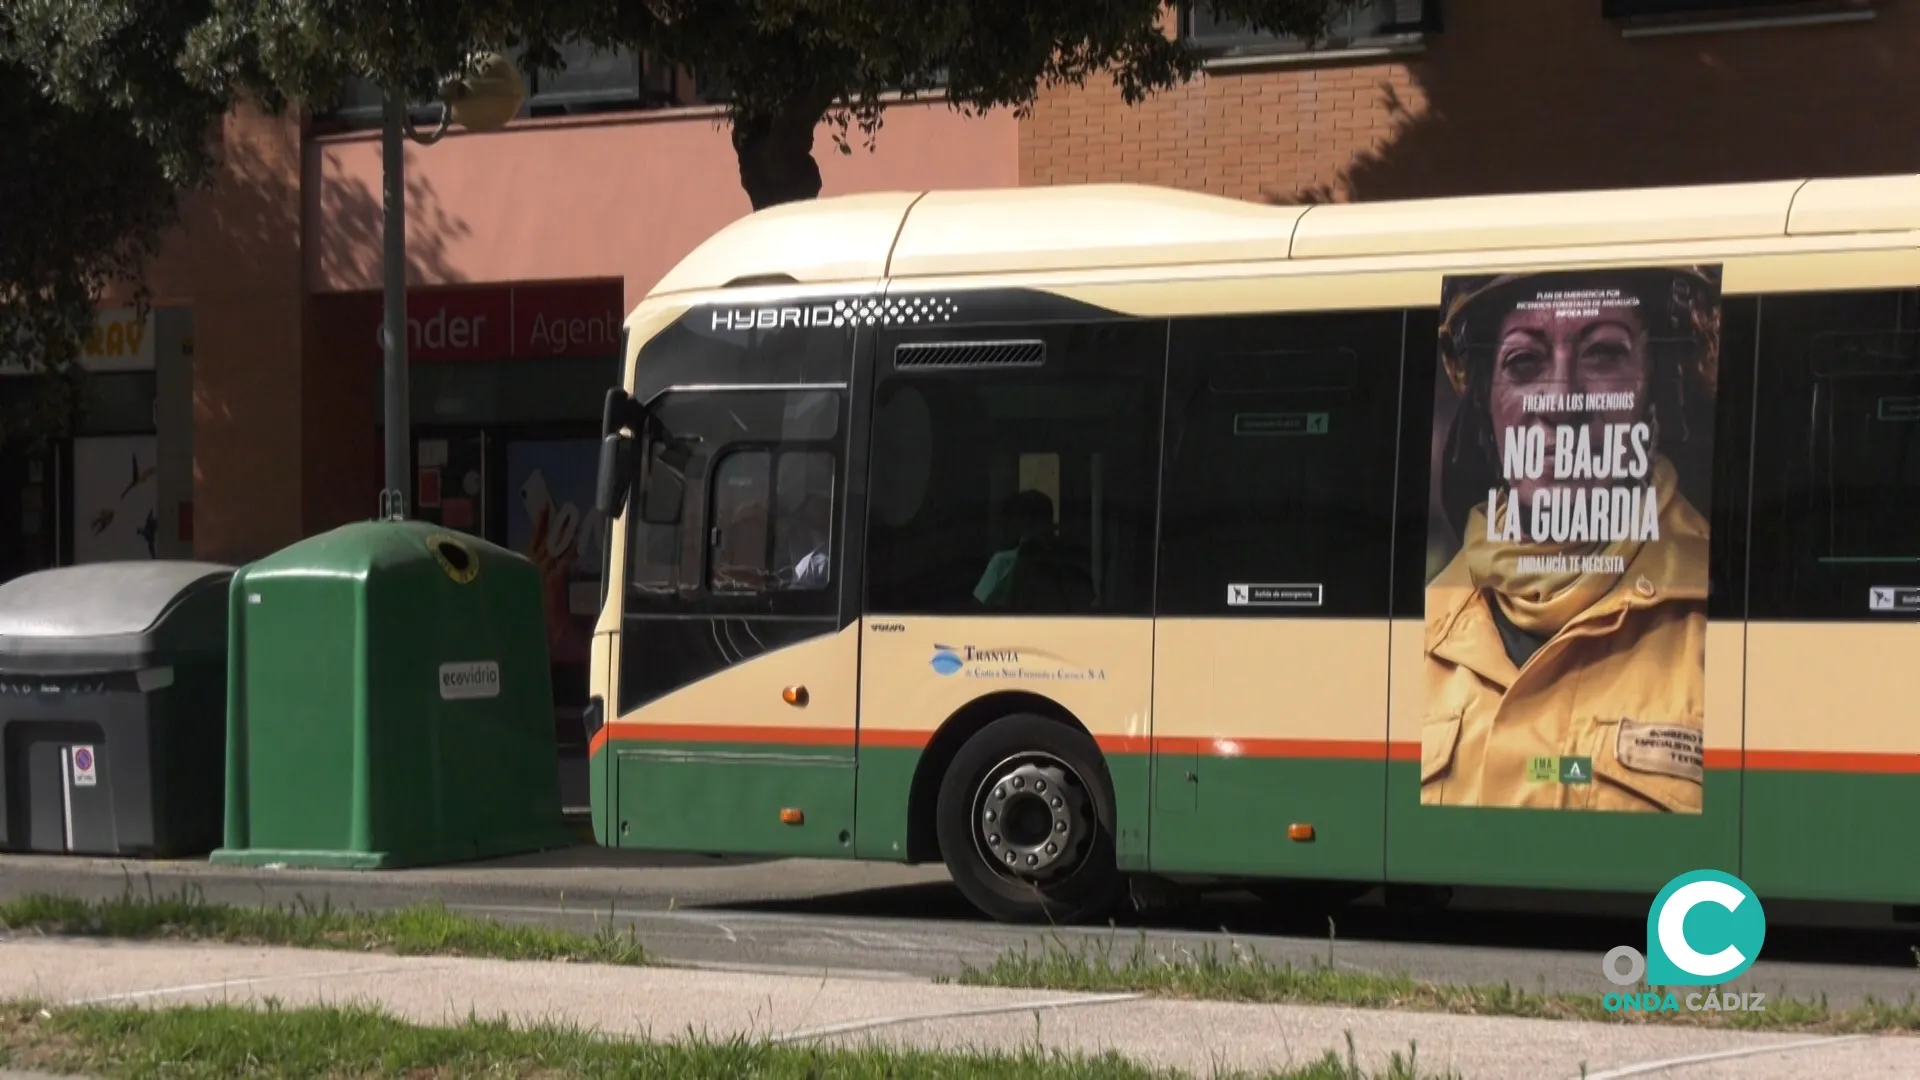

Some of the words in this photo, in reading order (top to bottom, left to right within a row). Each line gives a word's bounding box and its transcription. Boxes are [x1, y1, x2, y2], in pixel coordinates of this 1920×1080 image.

[711, 306, 834, 330] HYBRID
[1523, 393, 1556, 412] FRENTE
[1557, 393, 1565, 411] A
[1566, 393, 1584, 412] LOS
[1585, 392, 1635, 412] INCENDIOS
[1503, 424, 1546, 480] NO
[1554, 422, 1650, 480] BAJES
[1486, 487, 1522, 542] LA
[1530, 485, 1660, 543] GUARDIA
[1517, 552, 1567, 574] ANDALUCÍA
[1569, 555, 1580, 573] TE
[1581, 555, 1625, 574] NECESITA
[442, 664, 497, 686] ecovidrio
